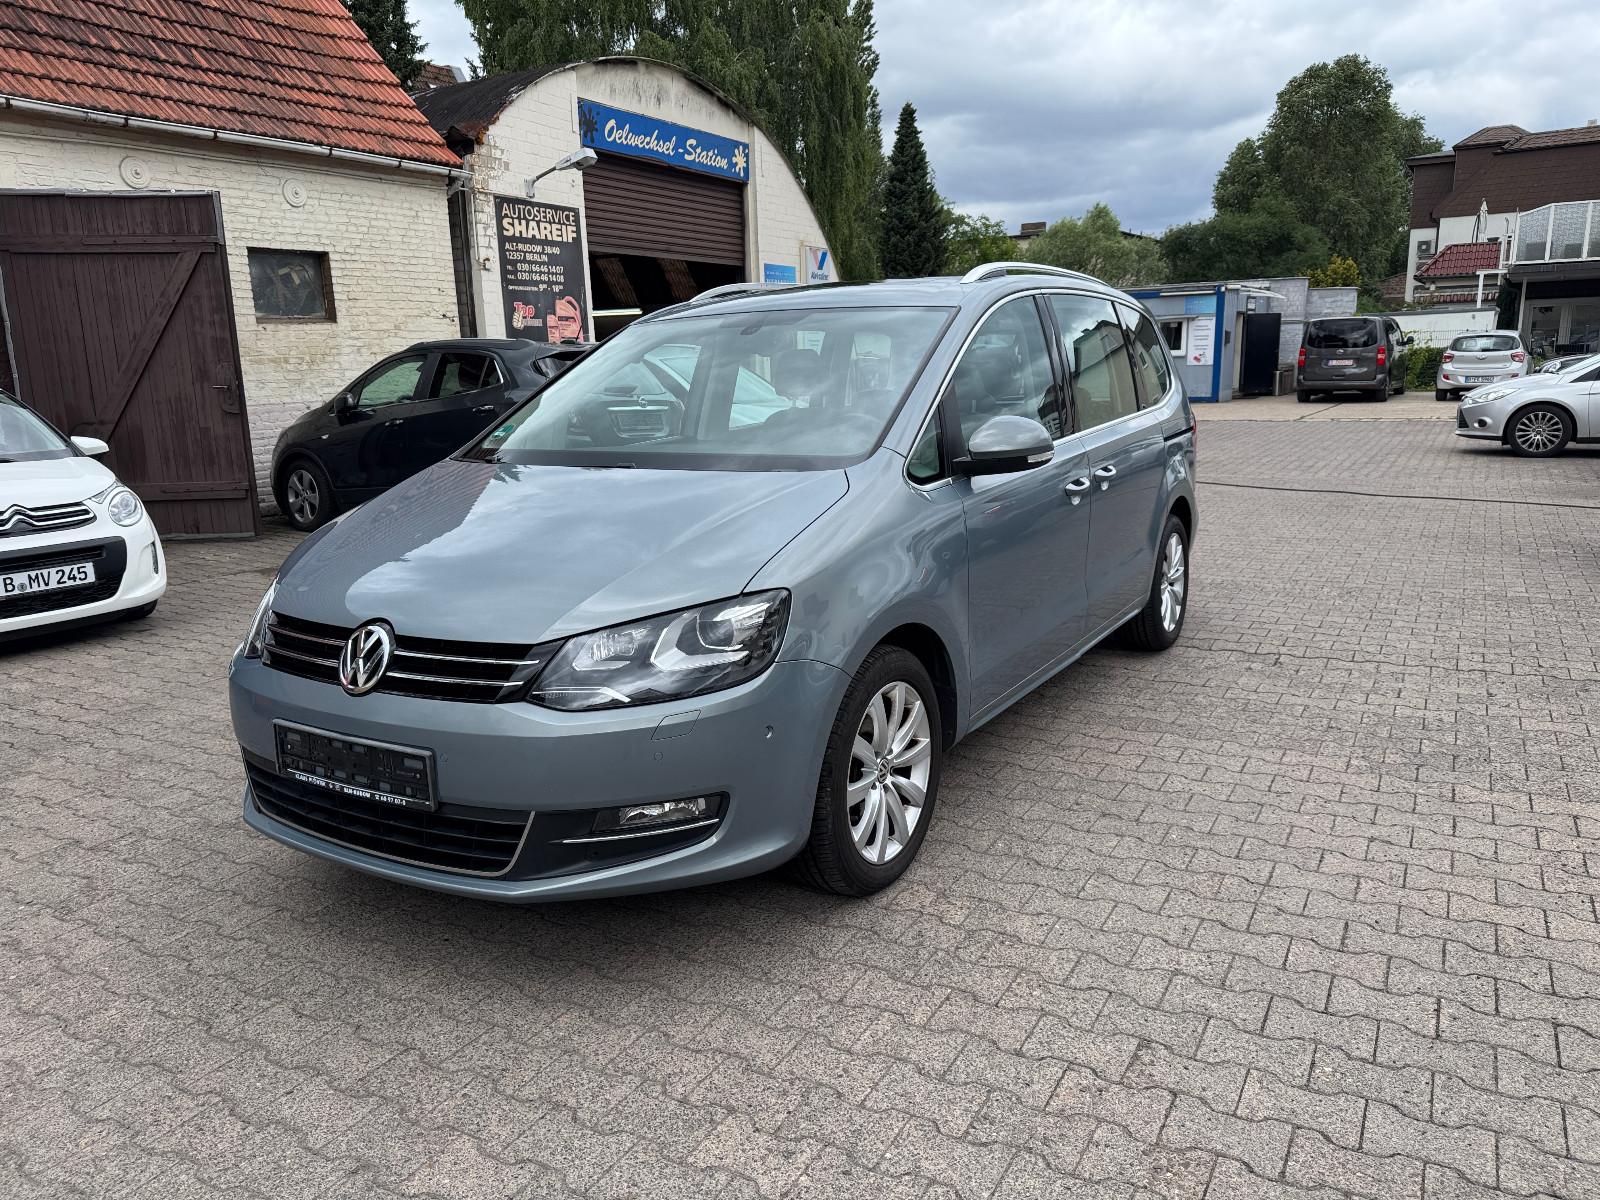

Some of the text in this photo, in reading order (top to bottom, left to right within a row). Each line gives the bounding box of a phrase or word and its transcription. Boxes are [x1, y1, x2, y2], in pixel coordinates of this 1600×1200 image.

[502, 203, 576, 225] AUTOSERVICE
[502, 218, 577, 243] SHAREIF
[504, 241, 543, 253] ALT-RUDOW
[506, 251, 548, 263] 12357 BERLIN
[514, 302, 535, 320] Top
[3, 565, 88, 593] B MV 245
